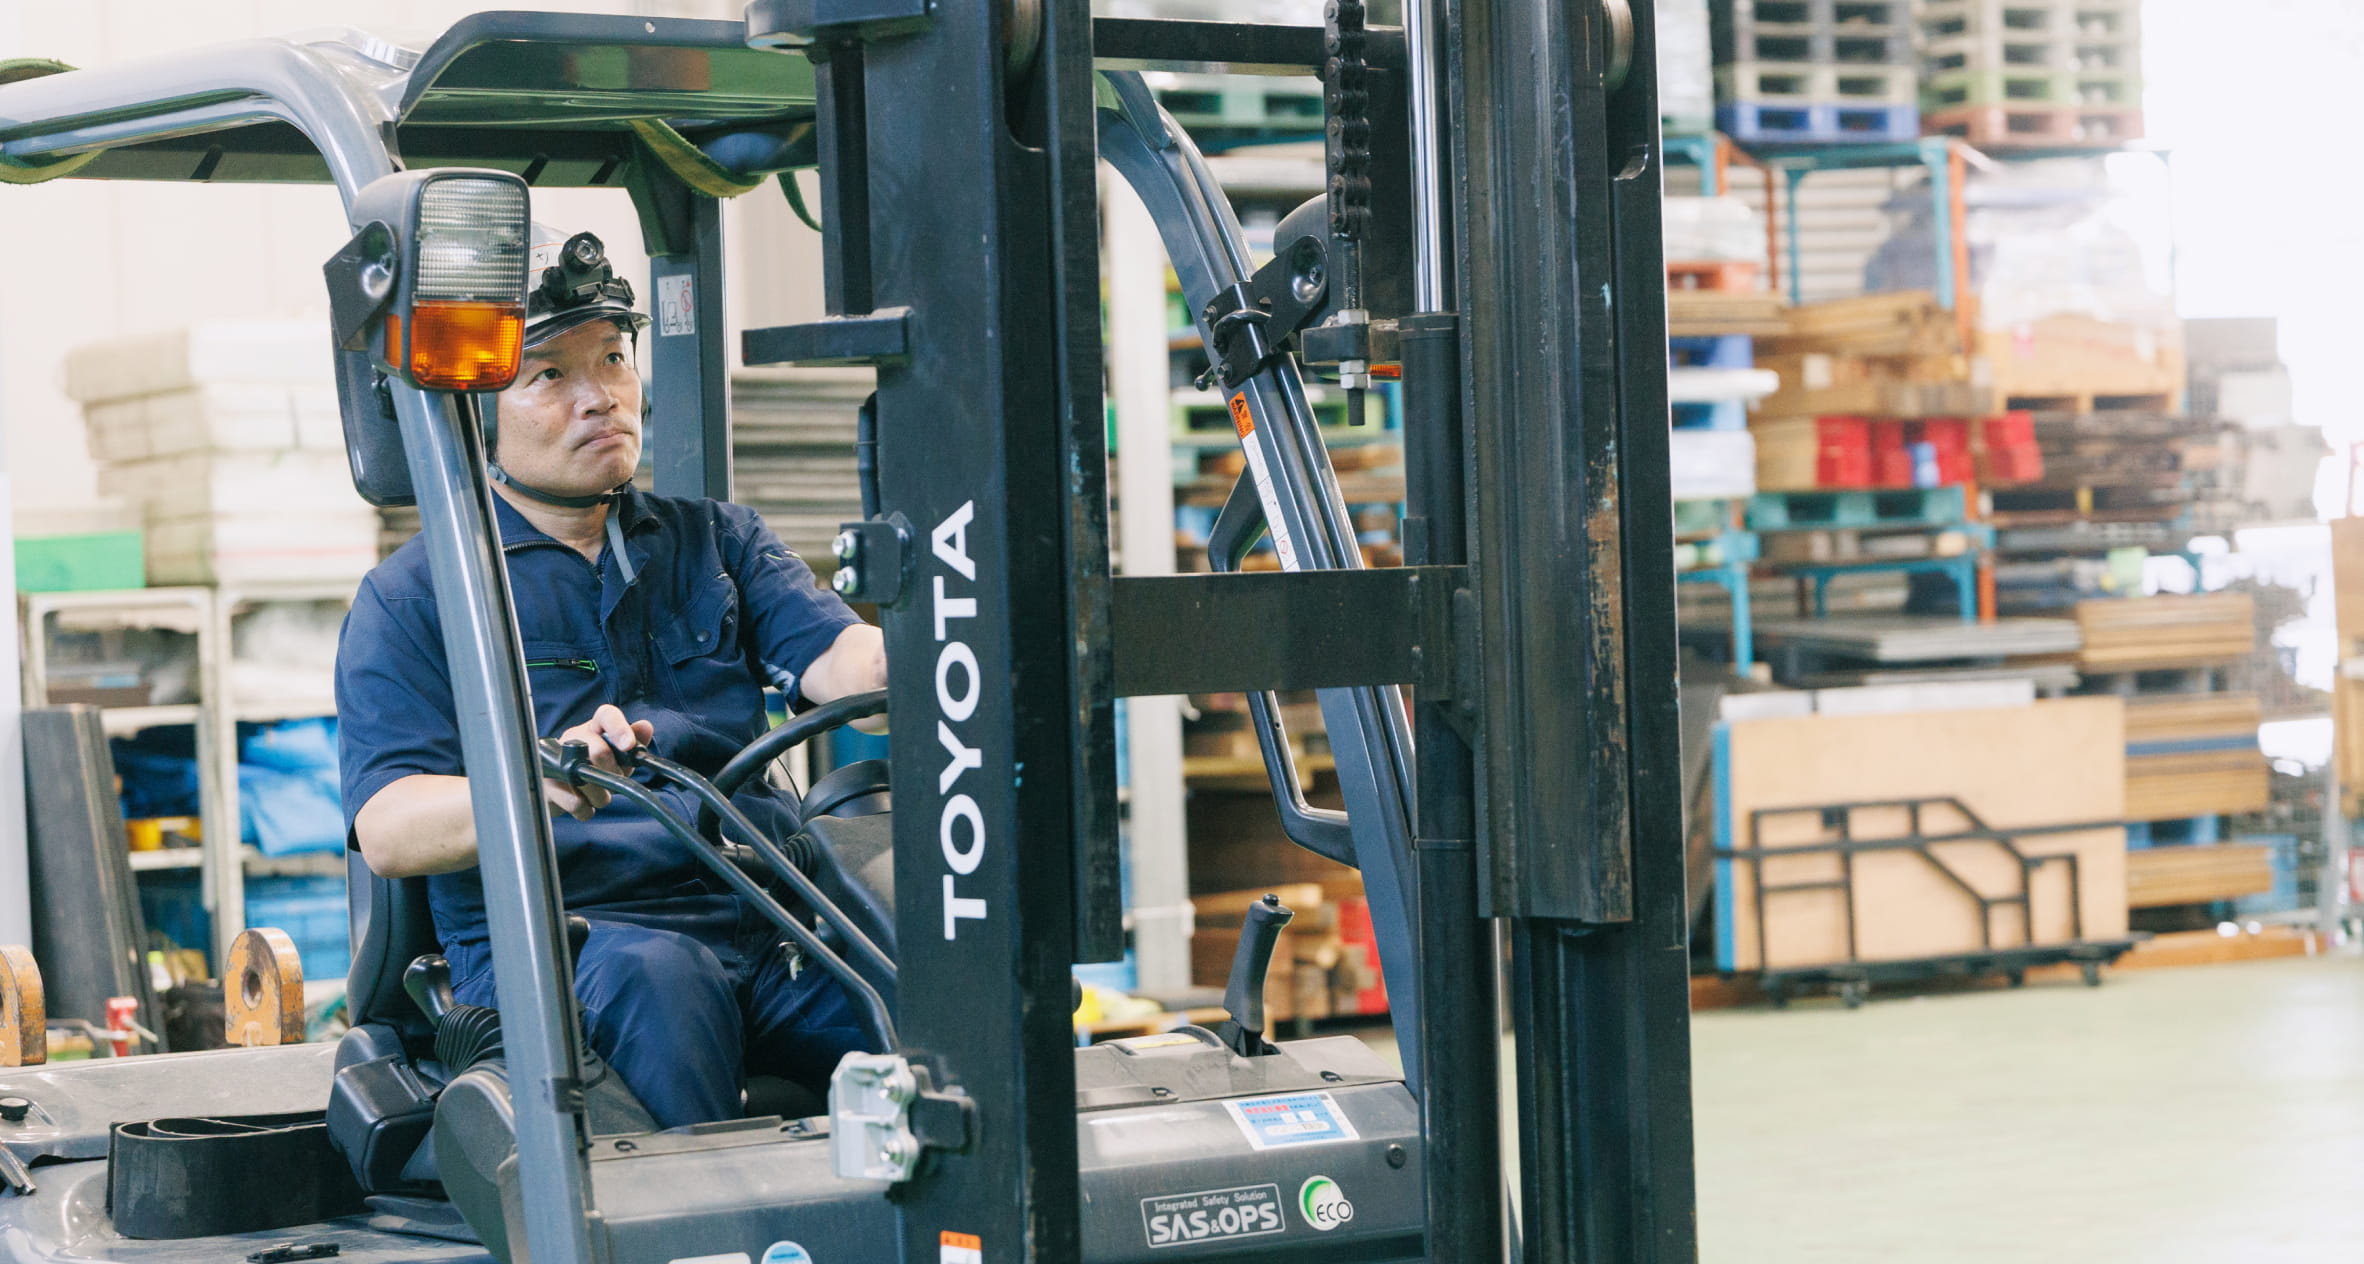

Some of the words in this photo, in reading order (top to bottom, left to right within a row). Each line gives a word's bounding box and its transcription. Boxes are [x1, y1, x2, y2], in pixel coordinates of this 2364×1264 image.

[931, 500, 987, 940] TOYOTA
[1155, 1198, 1198, 1213] Integrated
[1203, 1195, 1230, 1207] Safety
[1233, 1190, 1267, 1202] Solution
[1316, 1201, 1352, 1222] ECO
[1150, 1202, 1279, 1243] SAS&OPS
